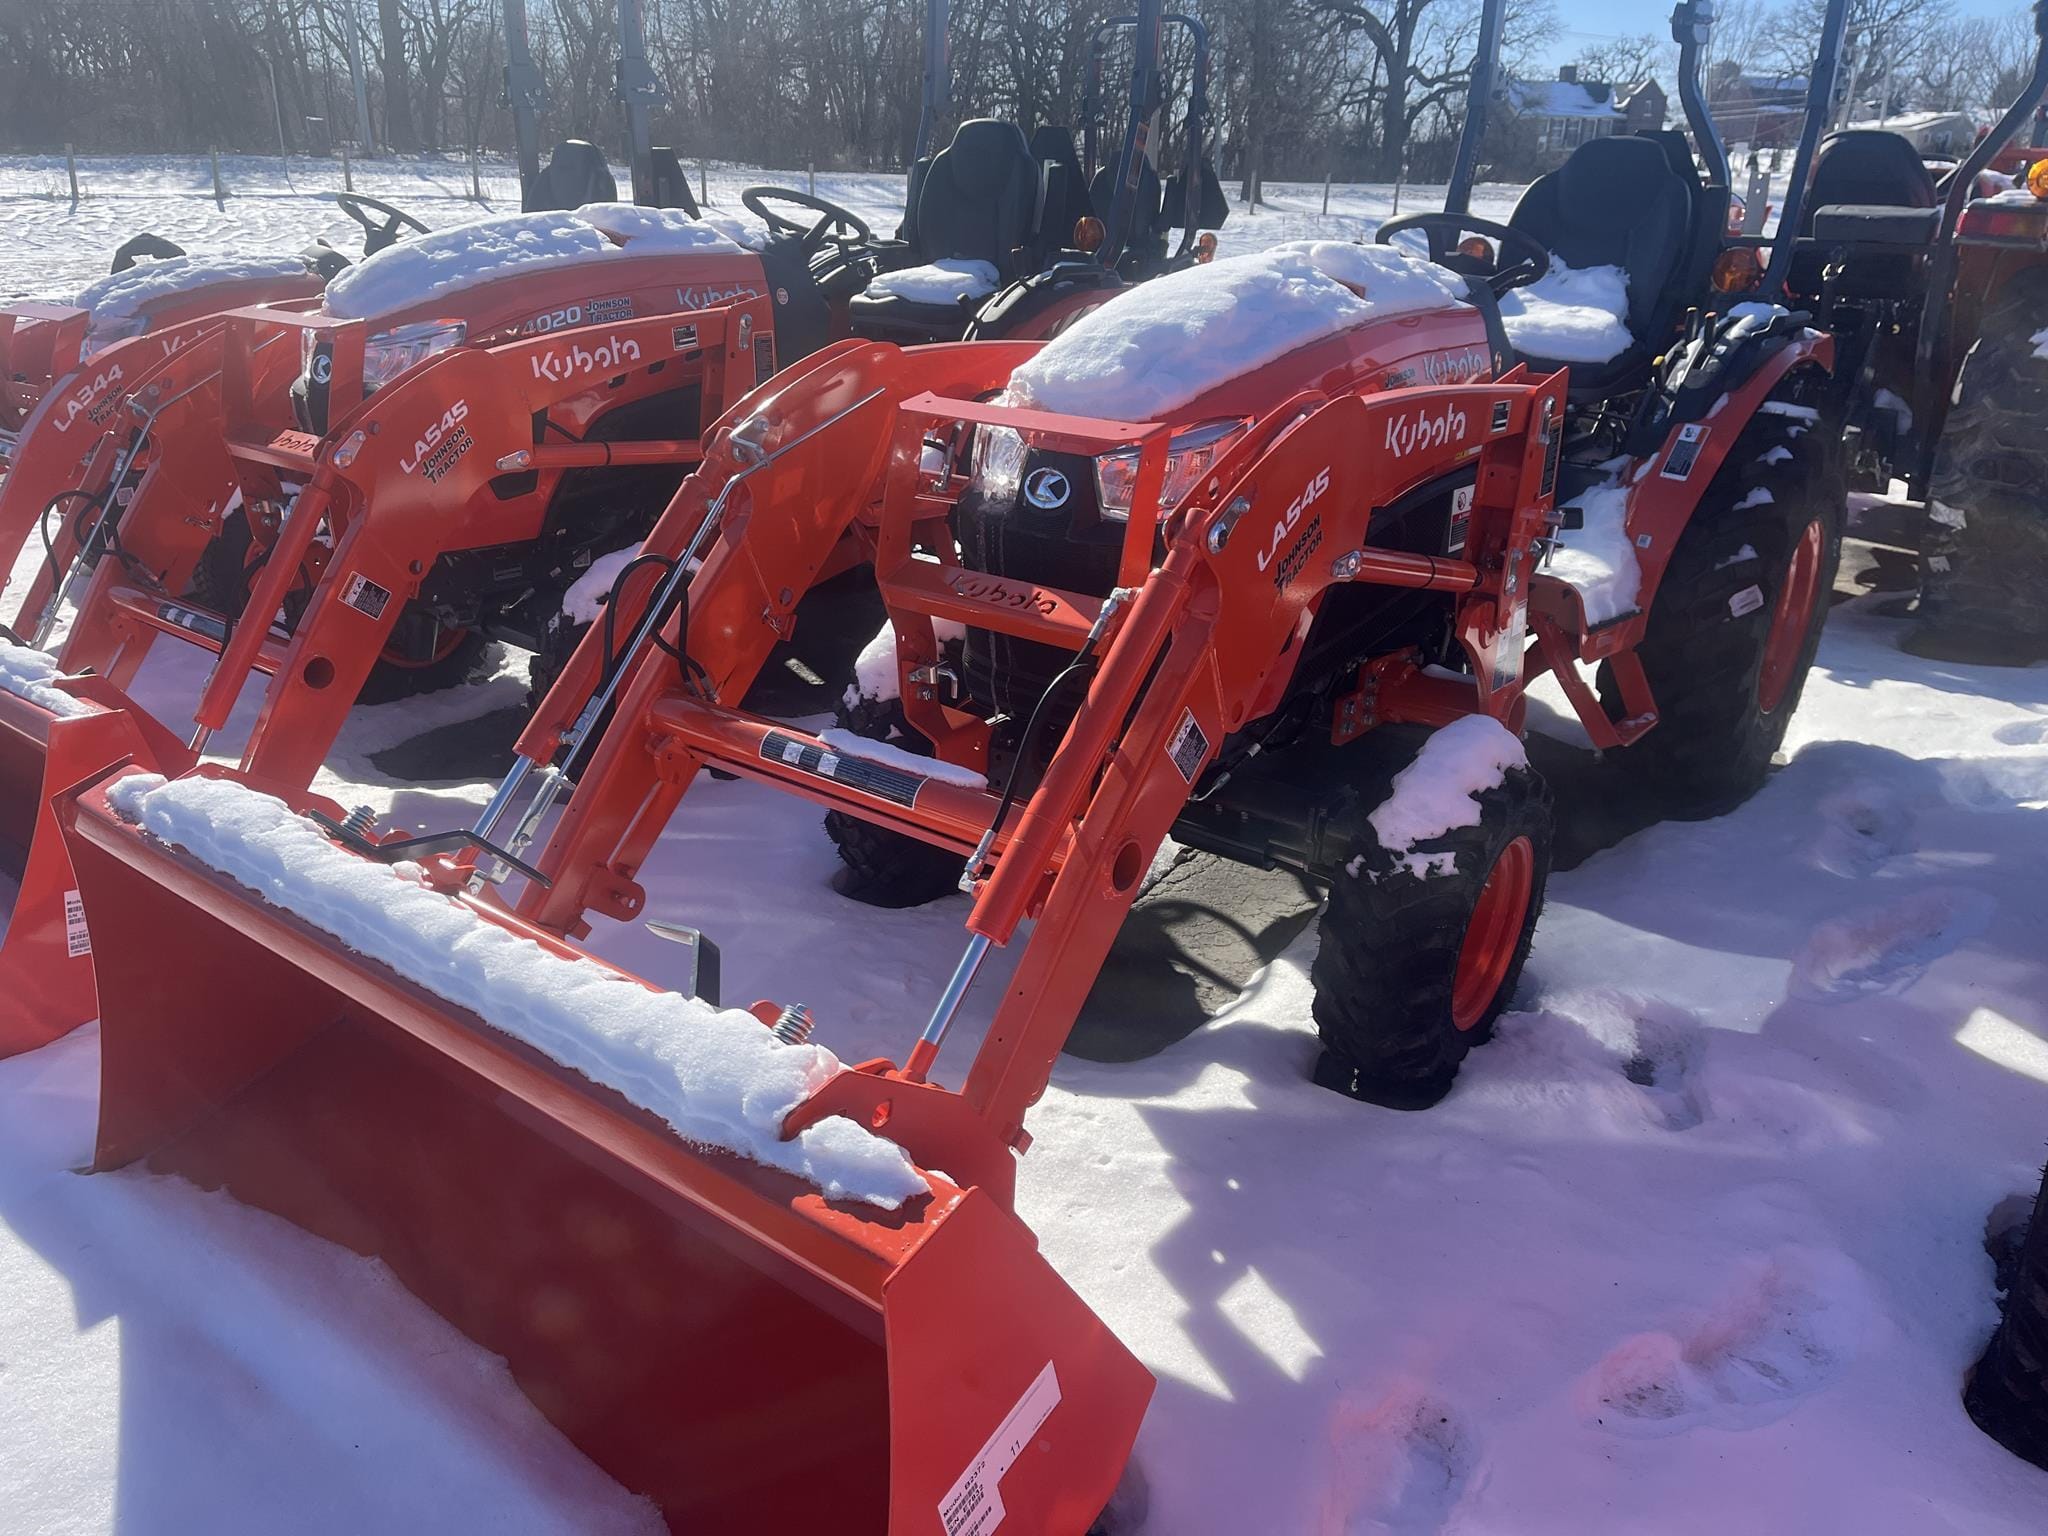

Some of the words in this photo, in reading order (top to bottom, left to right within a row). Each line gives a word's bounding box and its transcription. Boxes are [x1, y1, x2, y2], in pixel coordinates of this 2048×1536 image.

[585, 297, 631, 312] JOHNSON
[588, 309, 633, 323] TRACTOR
[531, 336, 640, 381] Kubota
[1423, 348, 1484, 386] Kubota
[53, 364, 124, 432] LA344
[87, 384, 123, 421] JOHNSON
[92, 405, 118, 427] TRAC
[400, 399, 469, 474] LA545
[422, 424, 467, 476] JOHNSON
[1385, 403, 1466, 458] Kubota
[427, 436, 474, 484] TRACTOR
[1257, 465, 1330, 572] LA545
[1274, 513, 1321, 585] JOHNSON
[1277, 530, 1323, 596] TRACTOR
[949, 575, 1058, 615] Kubota
